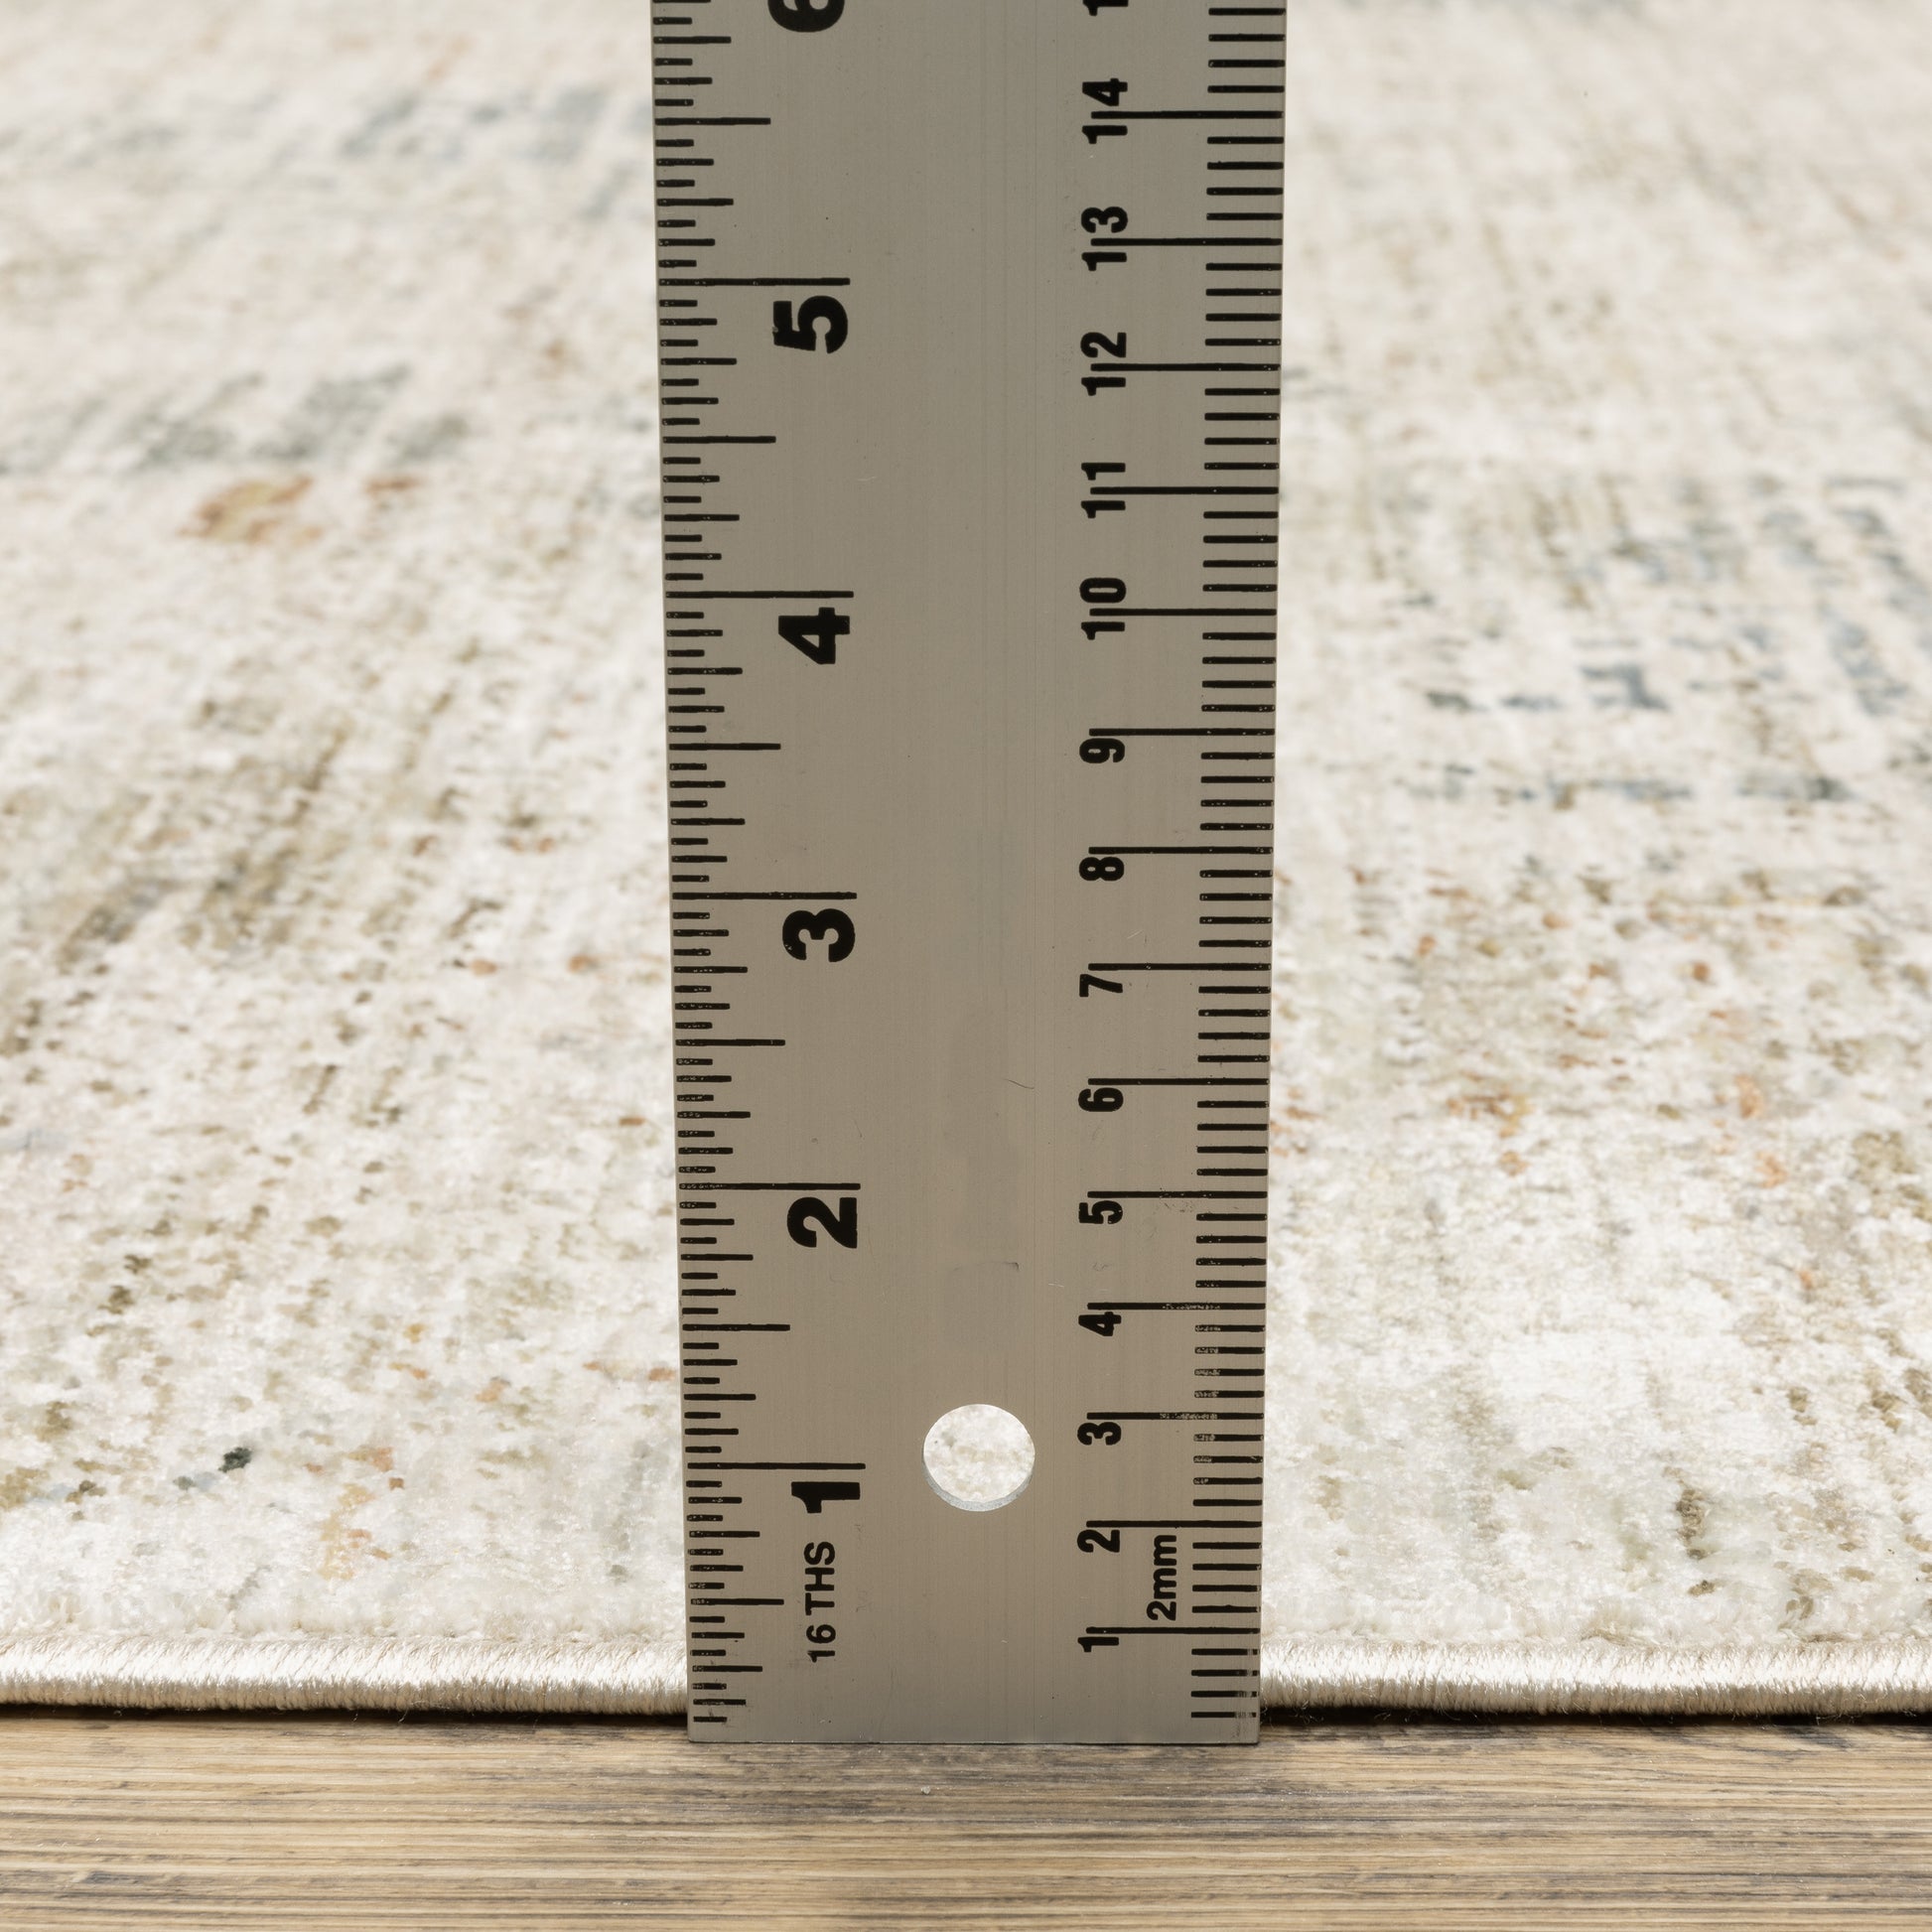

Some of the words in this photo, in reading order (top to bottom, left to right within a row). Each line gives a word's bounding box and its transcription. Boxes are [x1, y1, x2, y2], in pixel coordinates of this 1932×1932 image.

[1081, 0, 1131, 18] 1
[1080, 77, 1130, 145] 14
[1079, 205, 1129, 272] 13
[770, 294, 850, 355] 5
[1079, 331, 1128, 397] 12
[1079, 461, 1127, 519] 11
[1078, 576, 1127, 641] 10
[776, 606, 852, 666] 4
[1077, 736, 1127, 765] 9
[1077, 855, 1126, 883] 8
[780, 906, 857, 964] 3
[1077, 972, 1125, 999] 7
[1076, 1085, 1125, 1114] 6
[785, 1195, 860, 1250] 2
[1076, 1198, 1125, 1226] 5
[1076, 1310, 1123, 1337] 4
[1076, 1420, 1123, 1448] 3
[789, 1479, 862, 1515] 1
[1075, 1528, 1122, 1555] 2
[803, 1540, 837, 1617] THS
[1146, 1534, 1178, 1622] 2mm
[805, 1623, 837, 1664] 16
[1075, 1634, 1121, 1654] 1
